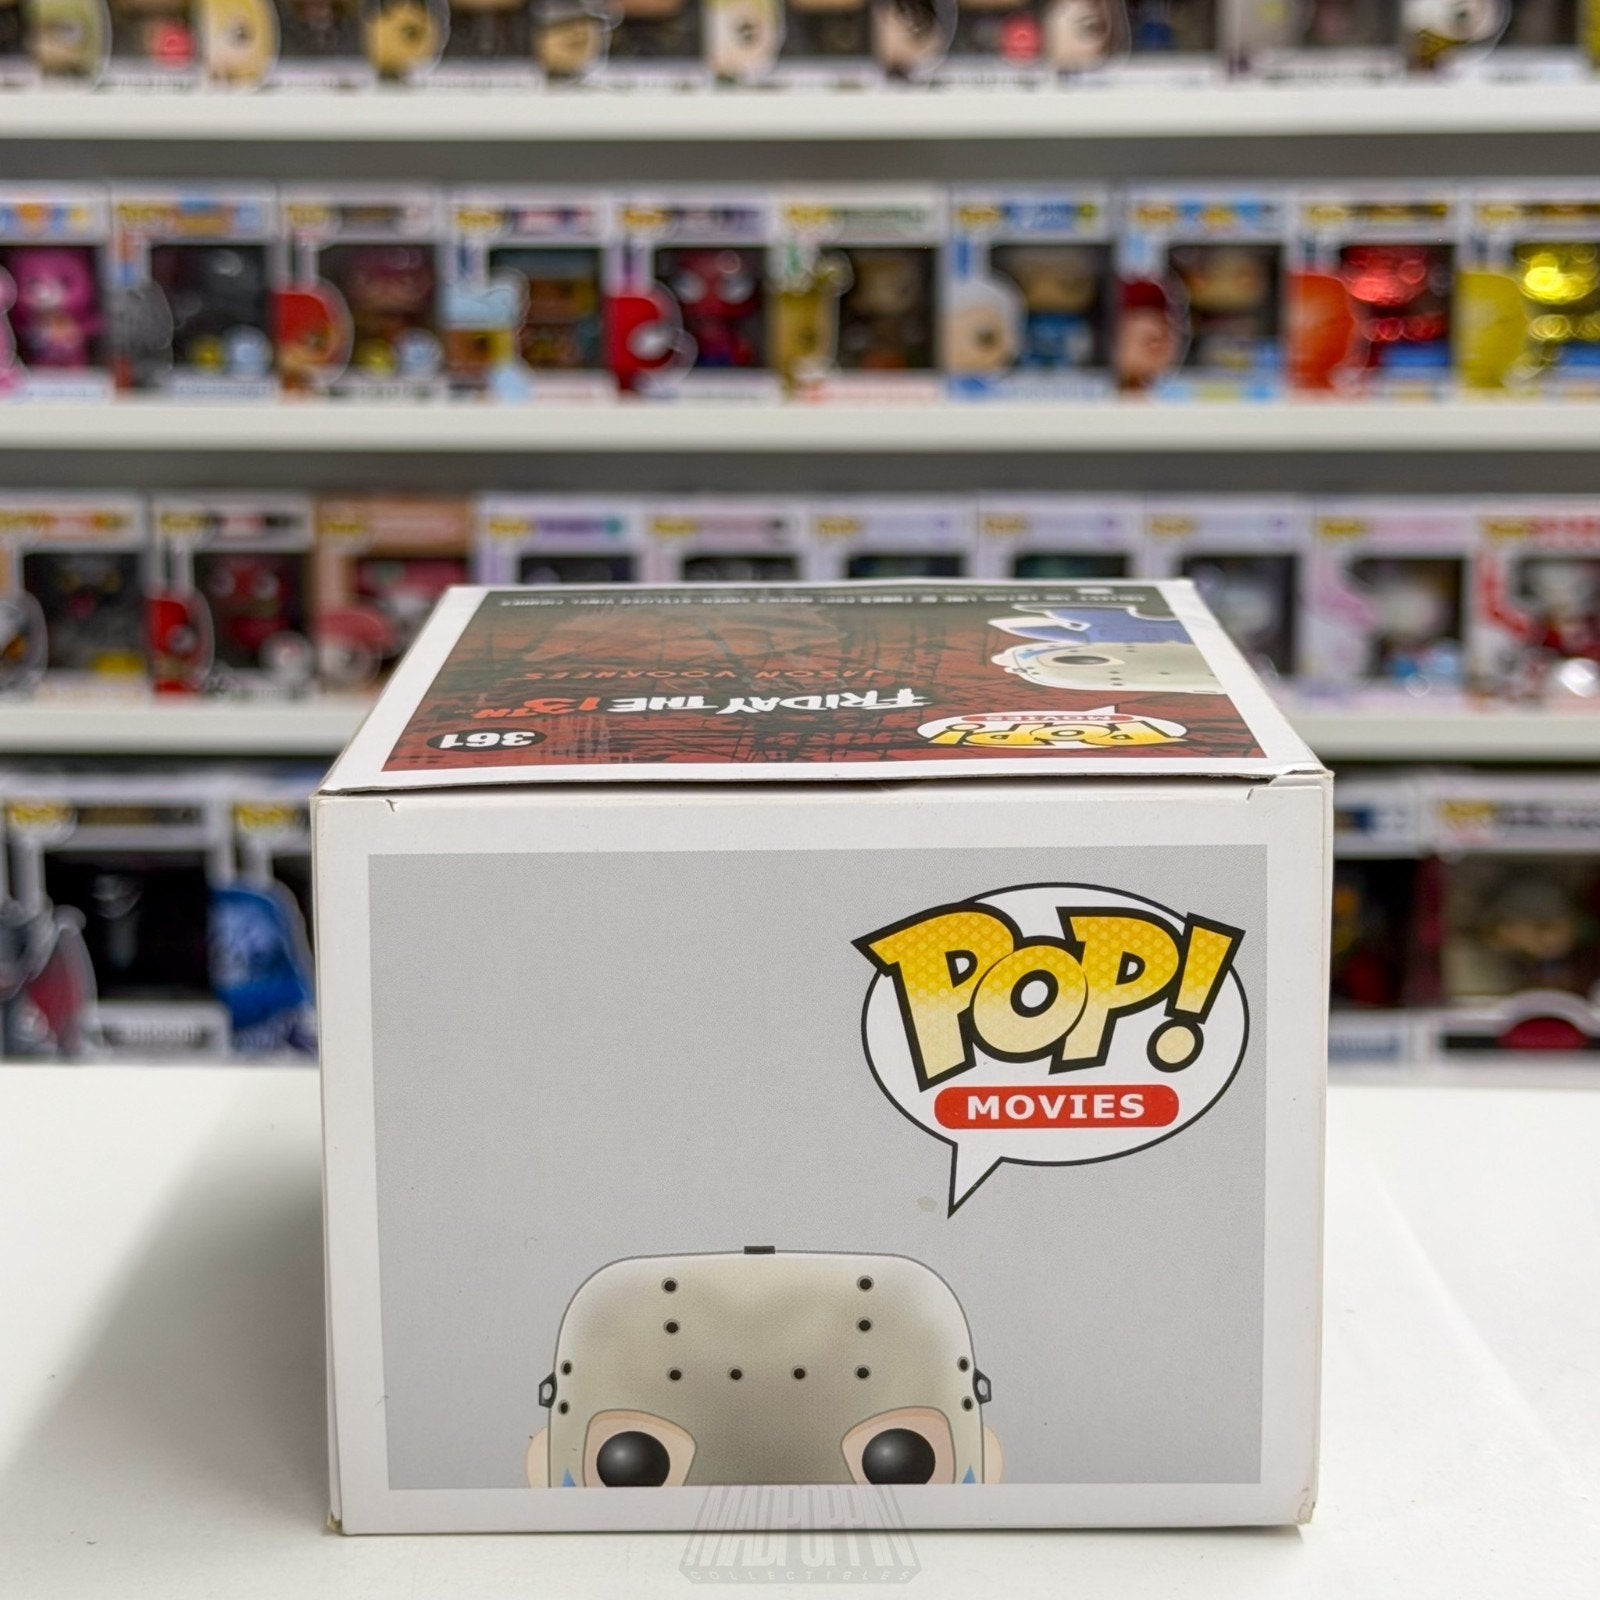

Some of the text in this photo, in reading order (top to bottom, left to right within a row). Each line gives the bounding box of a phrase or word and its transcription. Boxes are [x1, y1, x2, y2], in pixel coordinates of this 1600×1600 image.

[755, 670, 884, 678] JASON
[606, 696, 719, 713] THE
[716, 688, 933, 715] FRIDAY
[985, 714, 1112, 722] MOVIES
[439, 731, 536, 749] 361
[927, 721, 1190, 747] POP!
[850, 902, 1246, 1092] POP!
[966, 1093, 1146, 1120] MOVIES
